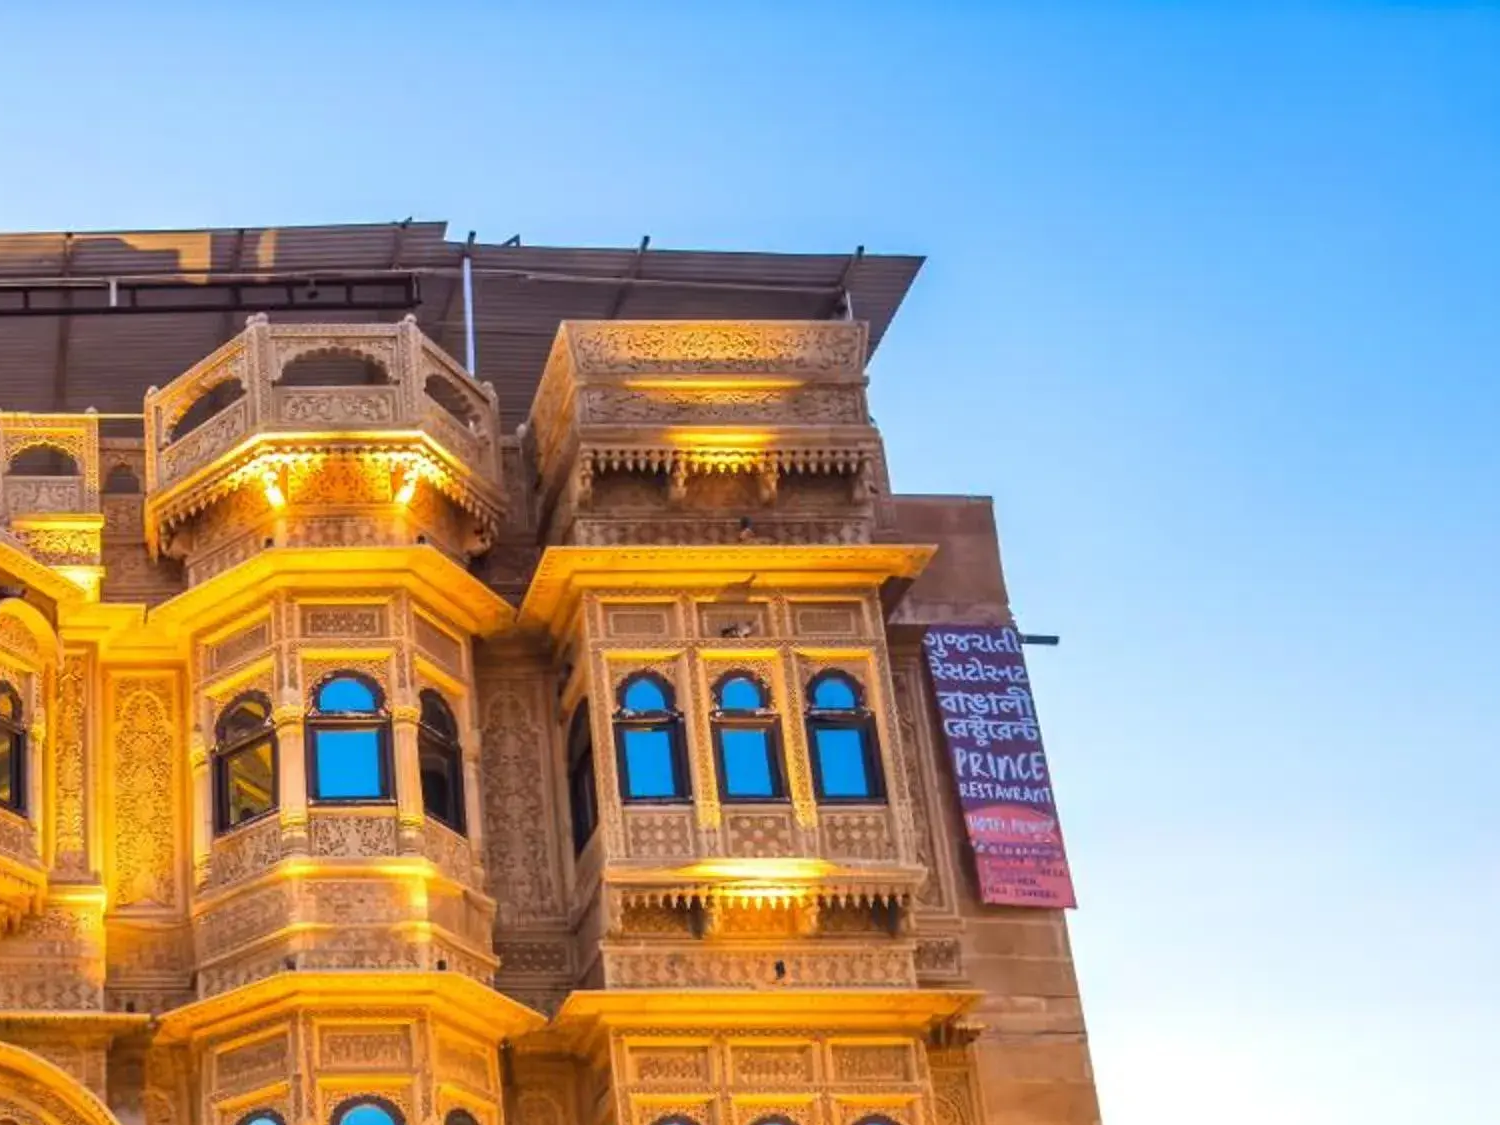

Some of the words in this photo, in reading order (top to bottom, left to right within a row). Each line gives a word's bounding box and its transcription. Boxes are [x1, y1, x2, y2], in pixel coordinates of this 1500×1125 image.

[922, 627, 1023, 658] ગુજરાતી
[953, 747, 1045, 781] PRINCE
[959, 782, 1052, 803] RESTAURANT
